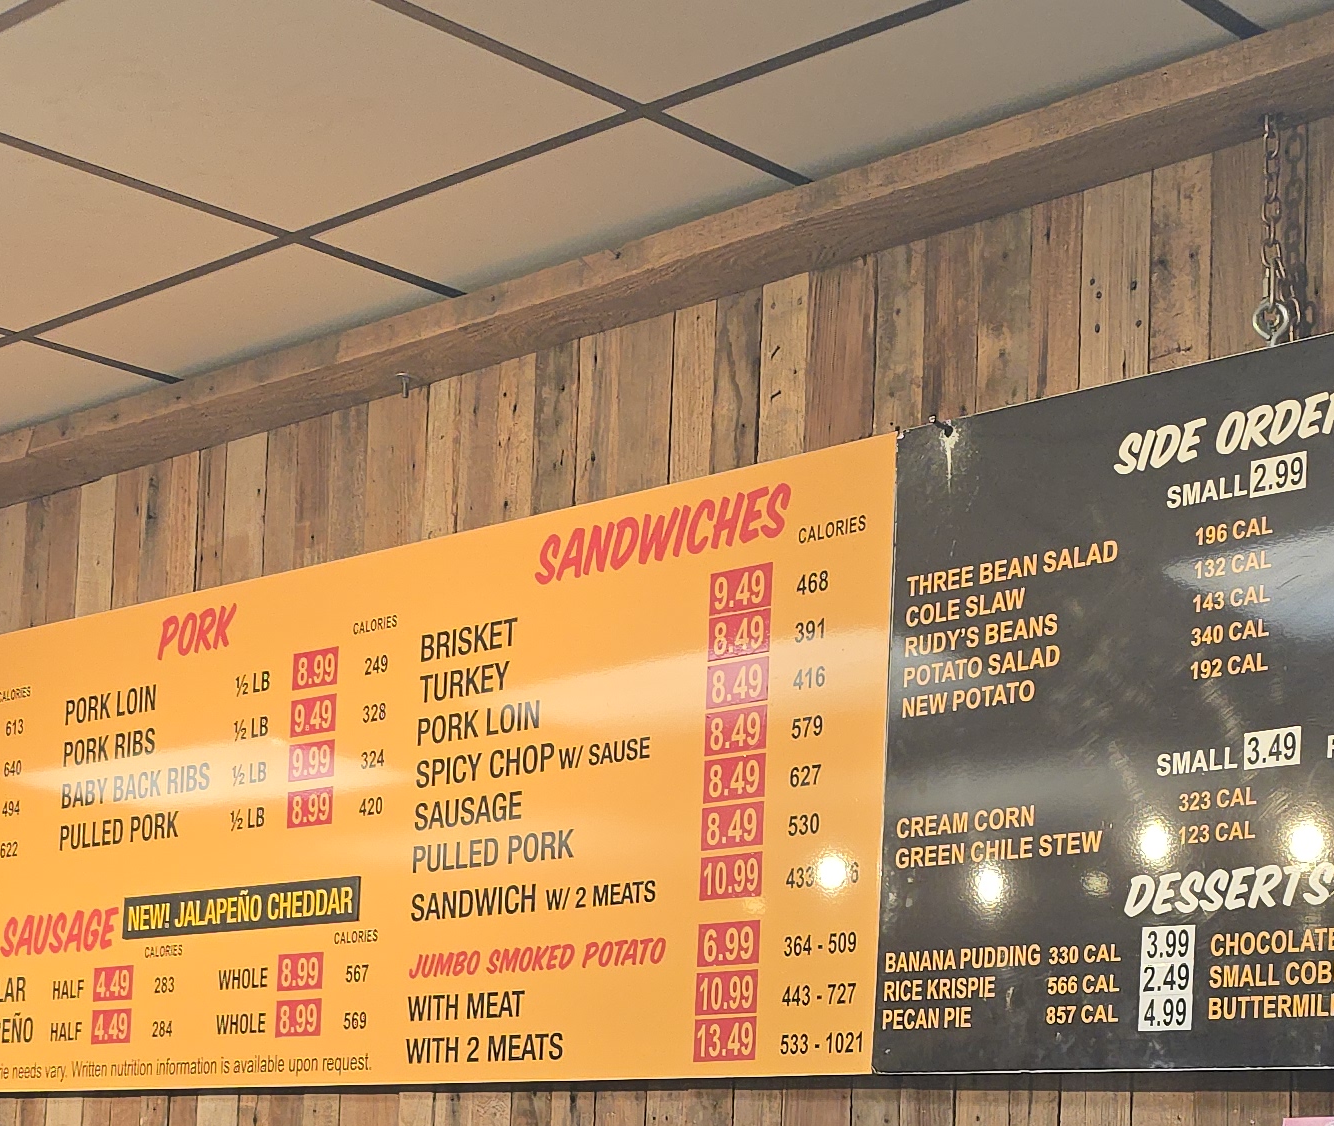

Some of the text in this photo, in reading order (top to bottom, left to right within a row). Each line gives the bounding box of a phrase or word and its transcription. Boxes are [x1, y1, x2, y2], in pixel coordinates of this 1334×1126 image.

[1113, 417, 1206, 475] SIDE
[1167, 457, 1303, 508] SMALL 2.99
[534, 482, 791, 585] SANDWICHES
[798, 515, 867, 545] CALORIES
[1195, 516, 1272, 545] 196 CAL
[797, 571, 829, 595] 468
[907, 540, 1118, 597] THREE BEAN SALAD
[714, 570, 765, 612] 9.49
[157, 603, 237, 661] PORK
[353, 615, 398, 635] CALORIES
[420, 617, 518, 663] BRISKET
[795, 619, 826, 644] 391
[904, 614, 1058, 657] RUDY'S BEANS
[297, 653, 335, 686] 8.99
[365, 655, 388, 675] 249
[421, 661, 510, 703] TURKEY
[65, 685, 156, 725] PORK LOIN
[6, 719, 24, 736] 613
[4, 760, 21, 776] 640
[61, 762, 210, 809] BABY BACK RIBS
[2, 801, 20, 817] 494
[359, 797, 382, 816] 420
[0, 842, 17, 858] 622
[895, 831, 1103, 868] GREEN CHILE STEW
[127, 886, 354, 933] NEW! JALAPEÑO CHEDDAR
[0, 907, 119, 957] SAUSAGE
[703, 925, 753, 962] 6.99
[1147, 930, 1189, 958] 3.99
[281, 957, 319, 987] 8.99
[408, 937, 667, 979] JUMBO SMOKED POTATO
[885, 944, 1121, 973] BANANA PUDDING 330 CAL
[96, 970, 129, 997] 4.49
[154, 976, 175, 994] 283
[218, 967, 268, 990] WHOLE
[346, 964, 368, 983] 567
[53, 979, 84, 1001] HALF
[406, 1033, 564, 1064] WITH 2 MEATS
[12, 1063, 41, 1079] needs
[45, 1065, 67, 1082] vary.
[72, 1060, 107, 1077] Written
[111, 1059, 152, 1077] nutrition
[156, 1058, 217, 1075] information
[221, 1057, 230, 1073] is
[233, 1055, 285, 1073] available
[288, 1058, 318, 1076] upon
[322, 1052, 371, 1074] request.
